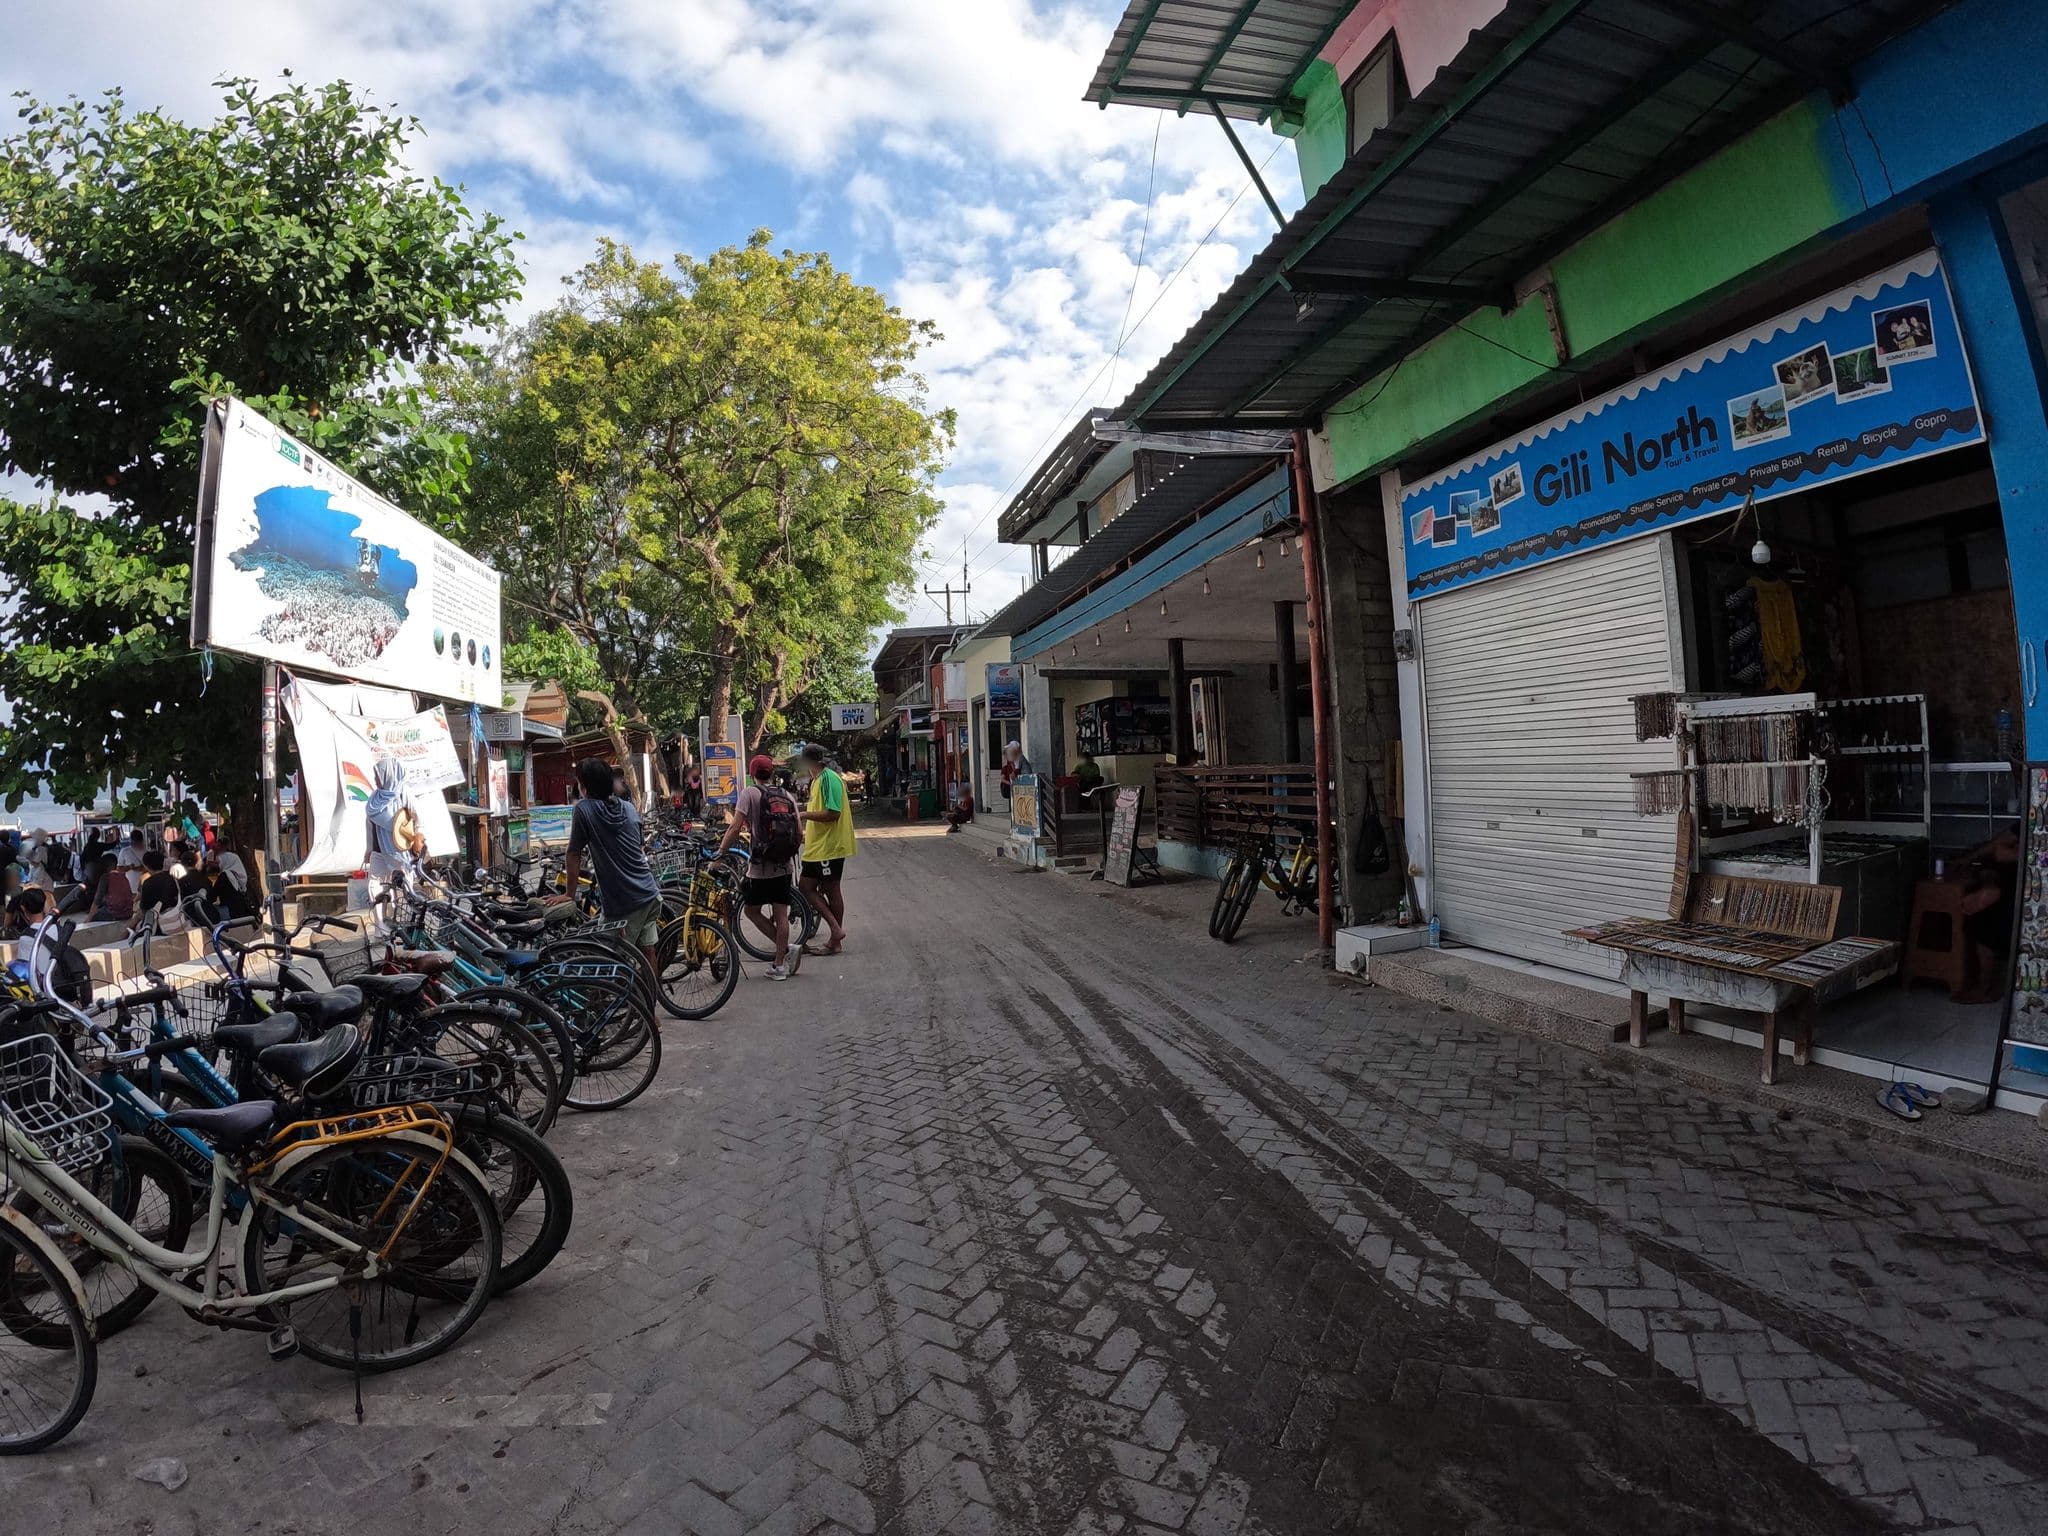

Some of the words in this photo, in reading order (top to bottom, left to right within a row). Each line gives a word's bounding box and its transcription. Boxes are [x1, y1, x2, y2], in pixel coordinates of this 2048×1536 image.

[1914, 412, 1948, 431] Gopro
[1862, 425, 1898, 446] Bicycle
[1533, 449, 1592, 507] Gili
[1601, 405, 1718, 485] North
[1664, 457, 1684, 469] Tour
[1685, 452, 1692, 463] &
[1692, 443, 1720, 460] Travel
[1816, 441, 1848, 459] Rental
[1750, 461, 1779, 479] Private
[1781, 454, 1803, 471] Boat
[1692, 480, 1720, 496] Private
[1721, 475, 1737, 488] Car
[1630, 500, 1655, 516] Shuttle
[1656, 493, 1684, 507] Service
[1579, 512, 1621, 532] Acomodation
[1556, 527, 1569, 539] Trip
[1507, 542, 1525, 554] Travel
[1525, 535, 1547, 550] Agency
[1483, 551, 1500, 562] Ticket
[1433, 564, 1460, 577] Information
[842, 715, 865, 725] DIVE
[43, 1190, 98, 1236] POLYGON
